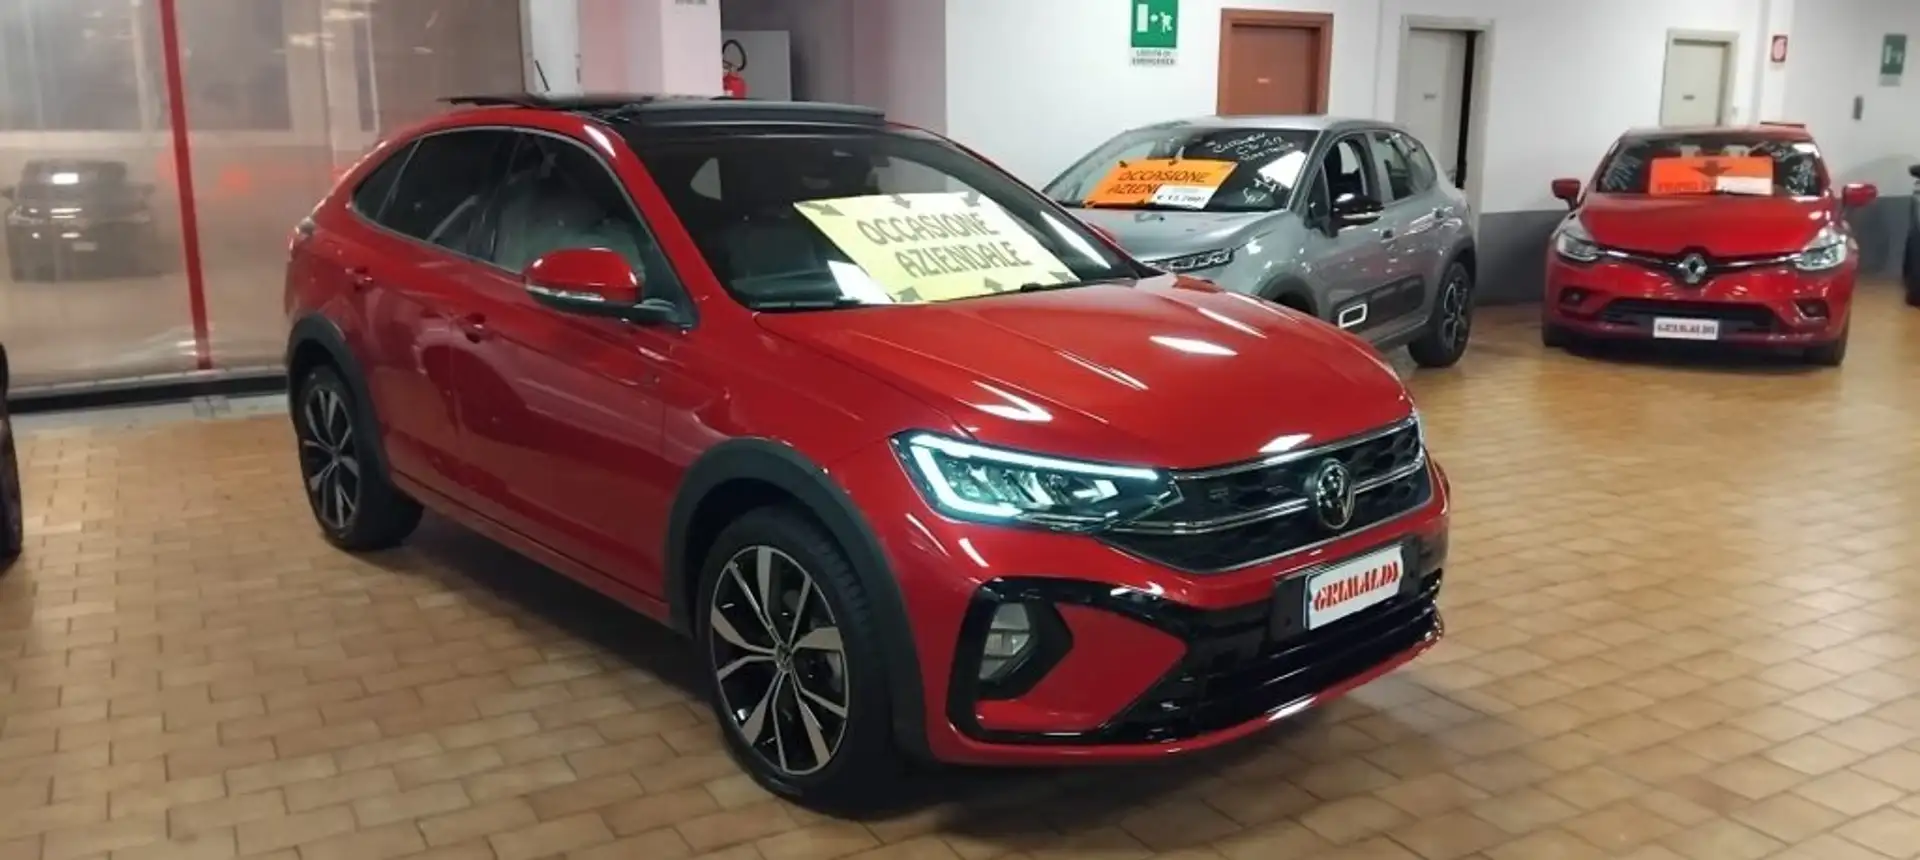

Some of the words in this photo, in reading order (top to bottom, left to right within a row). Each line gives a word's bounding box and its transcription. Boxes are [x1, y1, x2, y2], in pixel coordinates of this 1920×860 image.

[1118, 170, 1211, 183] OCCASIONE
[856, 212, 1000, 246] OCCASIONE
[894, 241, 1033, 278] AZIENDALE
[1314, 561, 1399, 612] GRIMALDI
